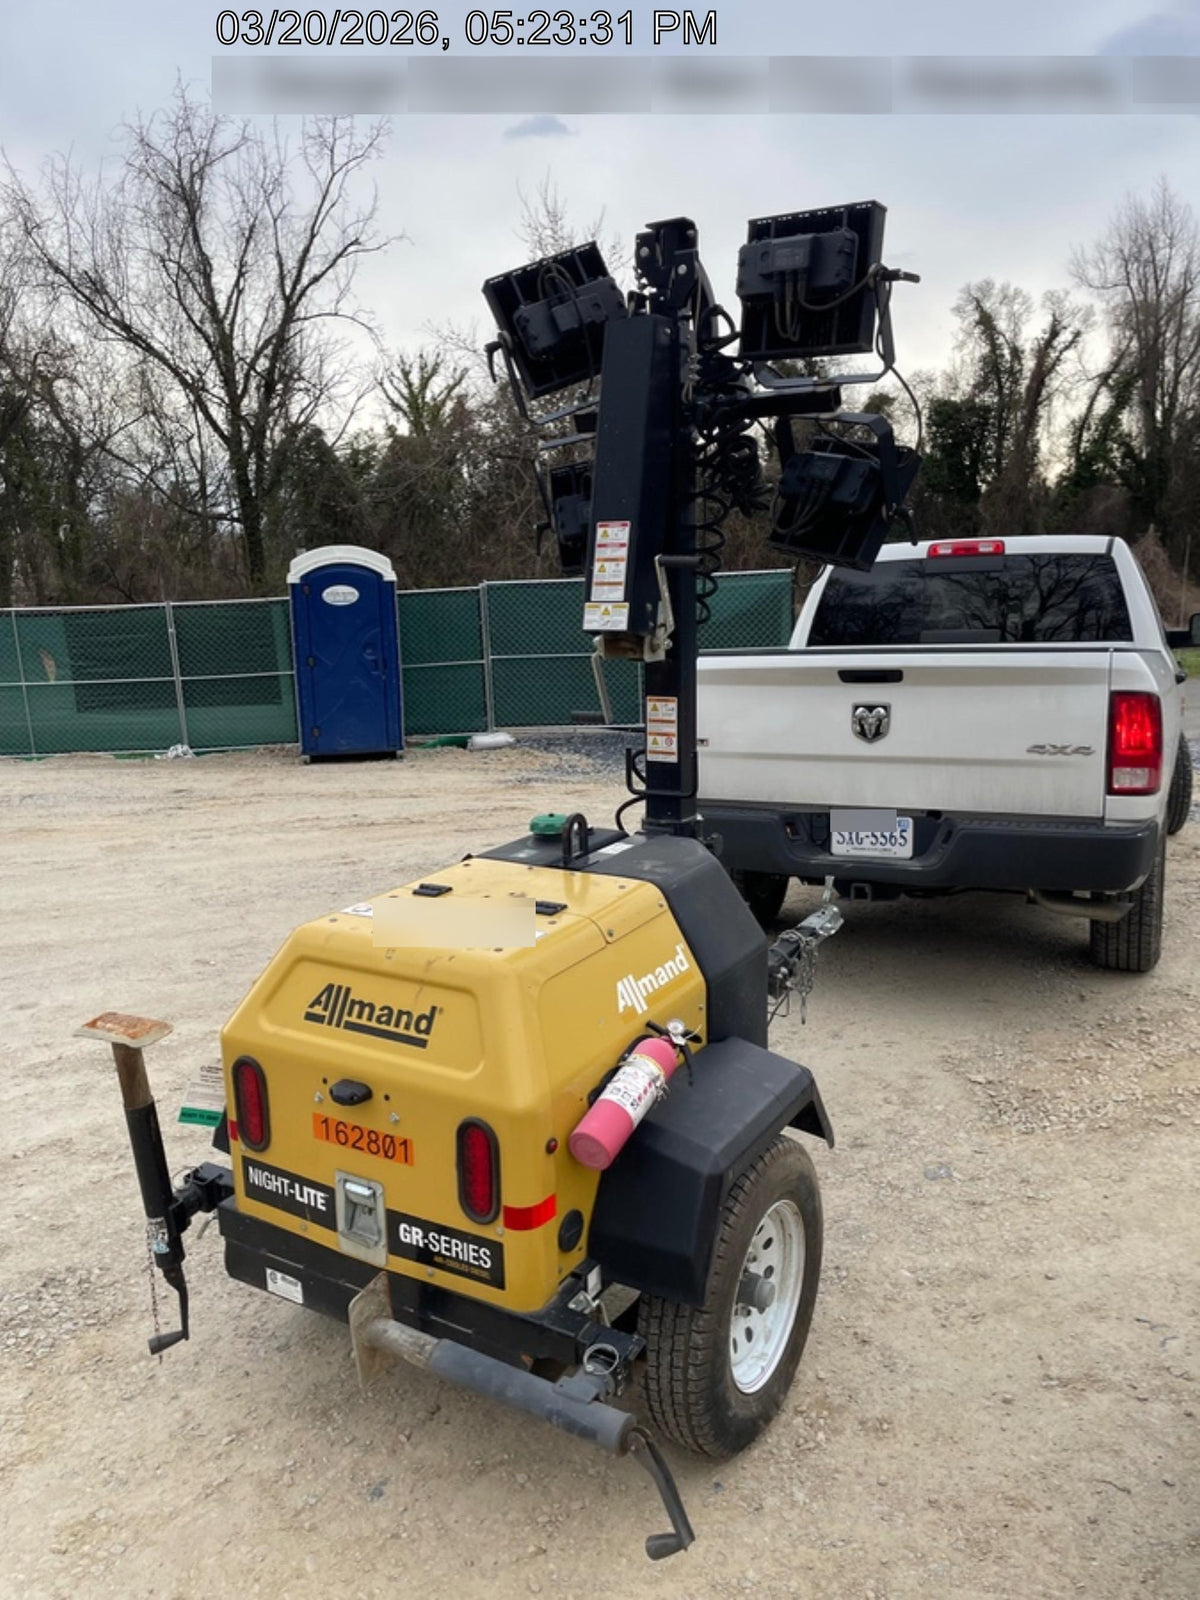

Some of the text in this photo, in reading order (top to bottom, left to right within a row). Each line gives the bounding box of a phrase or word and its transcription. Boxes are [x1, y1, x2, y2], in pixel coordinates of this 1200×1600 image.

[616, 944, 690, 1015] Allmand
[305, 983, 438, 1042] Allmand
[320, 1117, 409, 1163] 162801
[248, 1166, 328, 1211] NIGHT-LITE
[398, 1222, 492, 1269] GR-SERIES
